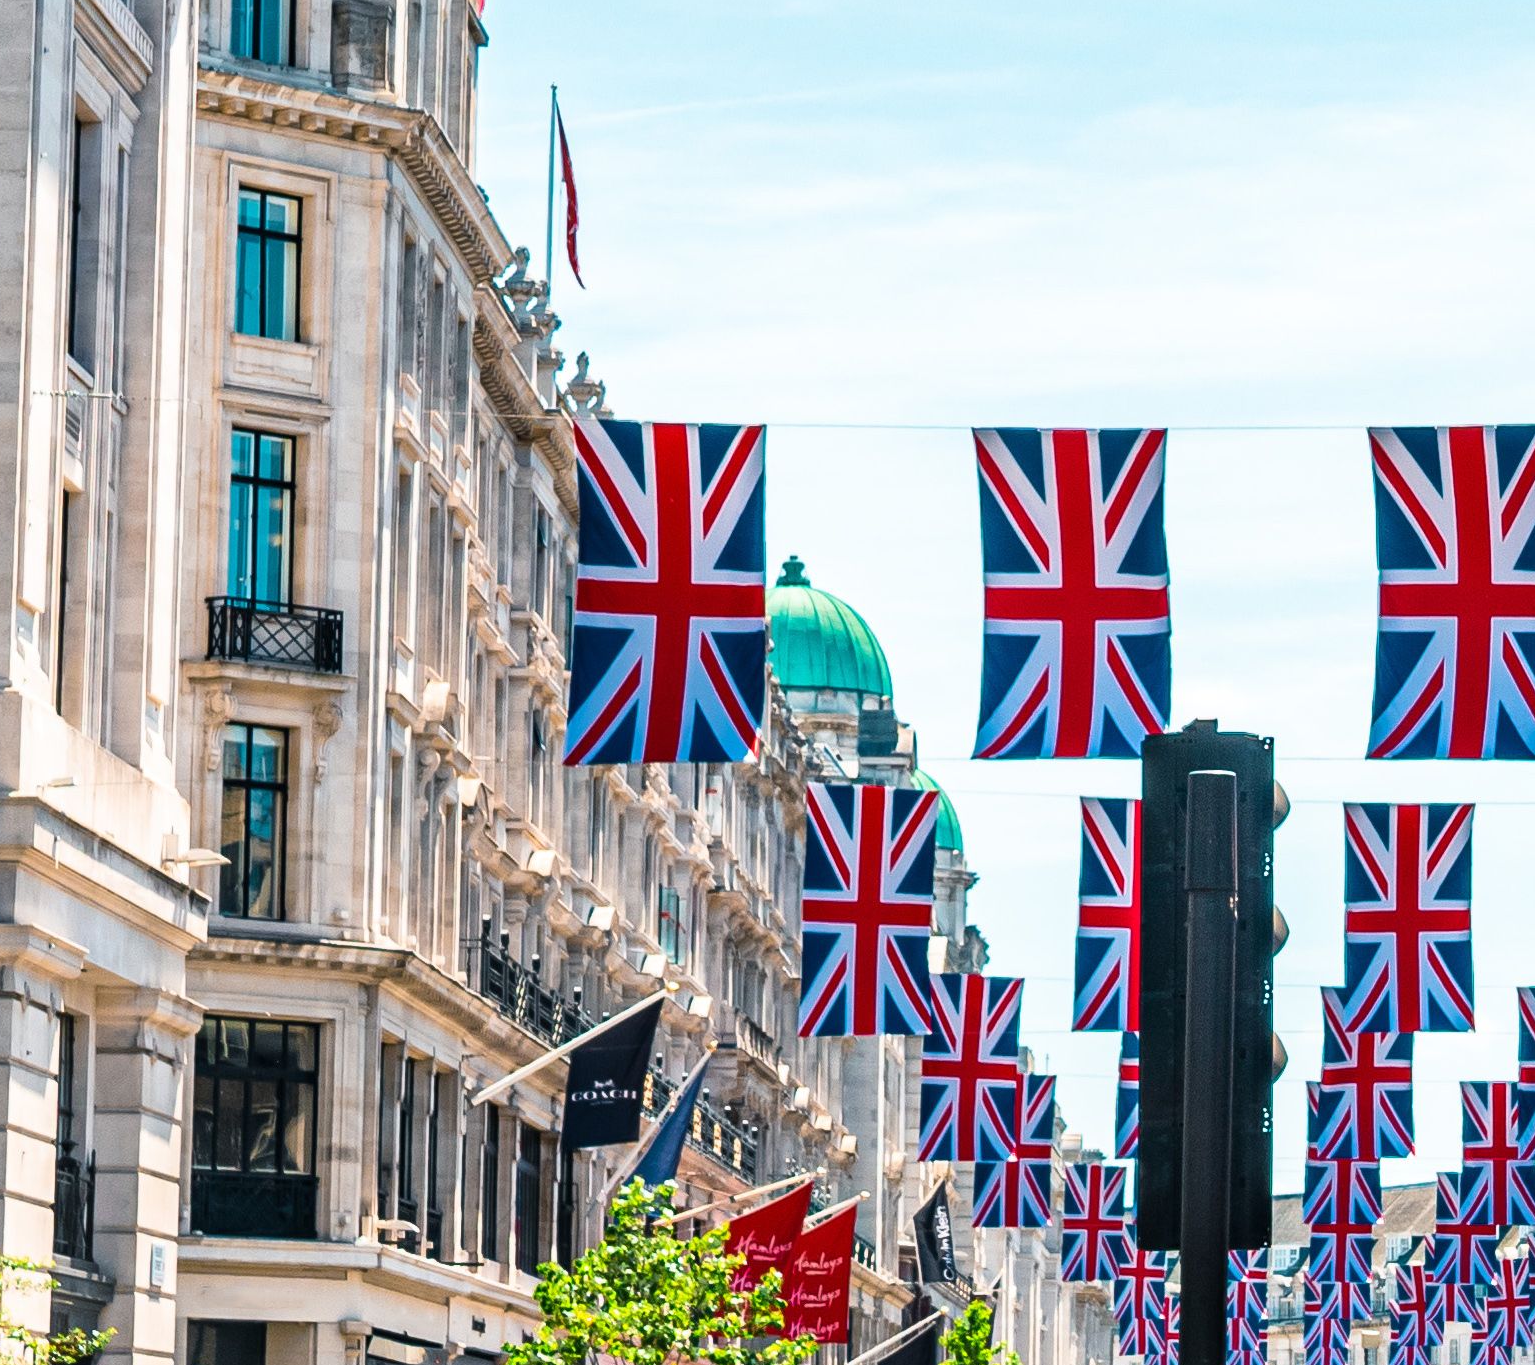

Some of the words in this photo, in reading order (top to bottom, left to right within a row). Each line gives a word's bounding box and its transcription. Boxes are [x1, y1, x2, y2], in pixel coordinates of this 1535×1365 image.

[571, 1090, 637, 1102] COACH
[934, 1205, 951, 1238] Klein
[734, 1230, 793, 1256] Hamleys
[793, 1251, 843, 1275] Hamleys
[790, 1282, 841, 1308] Hamleys
[789, 1316, 840, 1340] Hamleys
